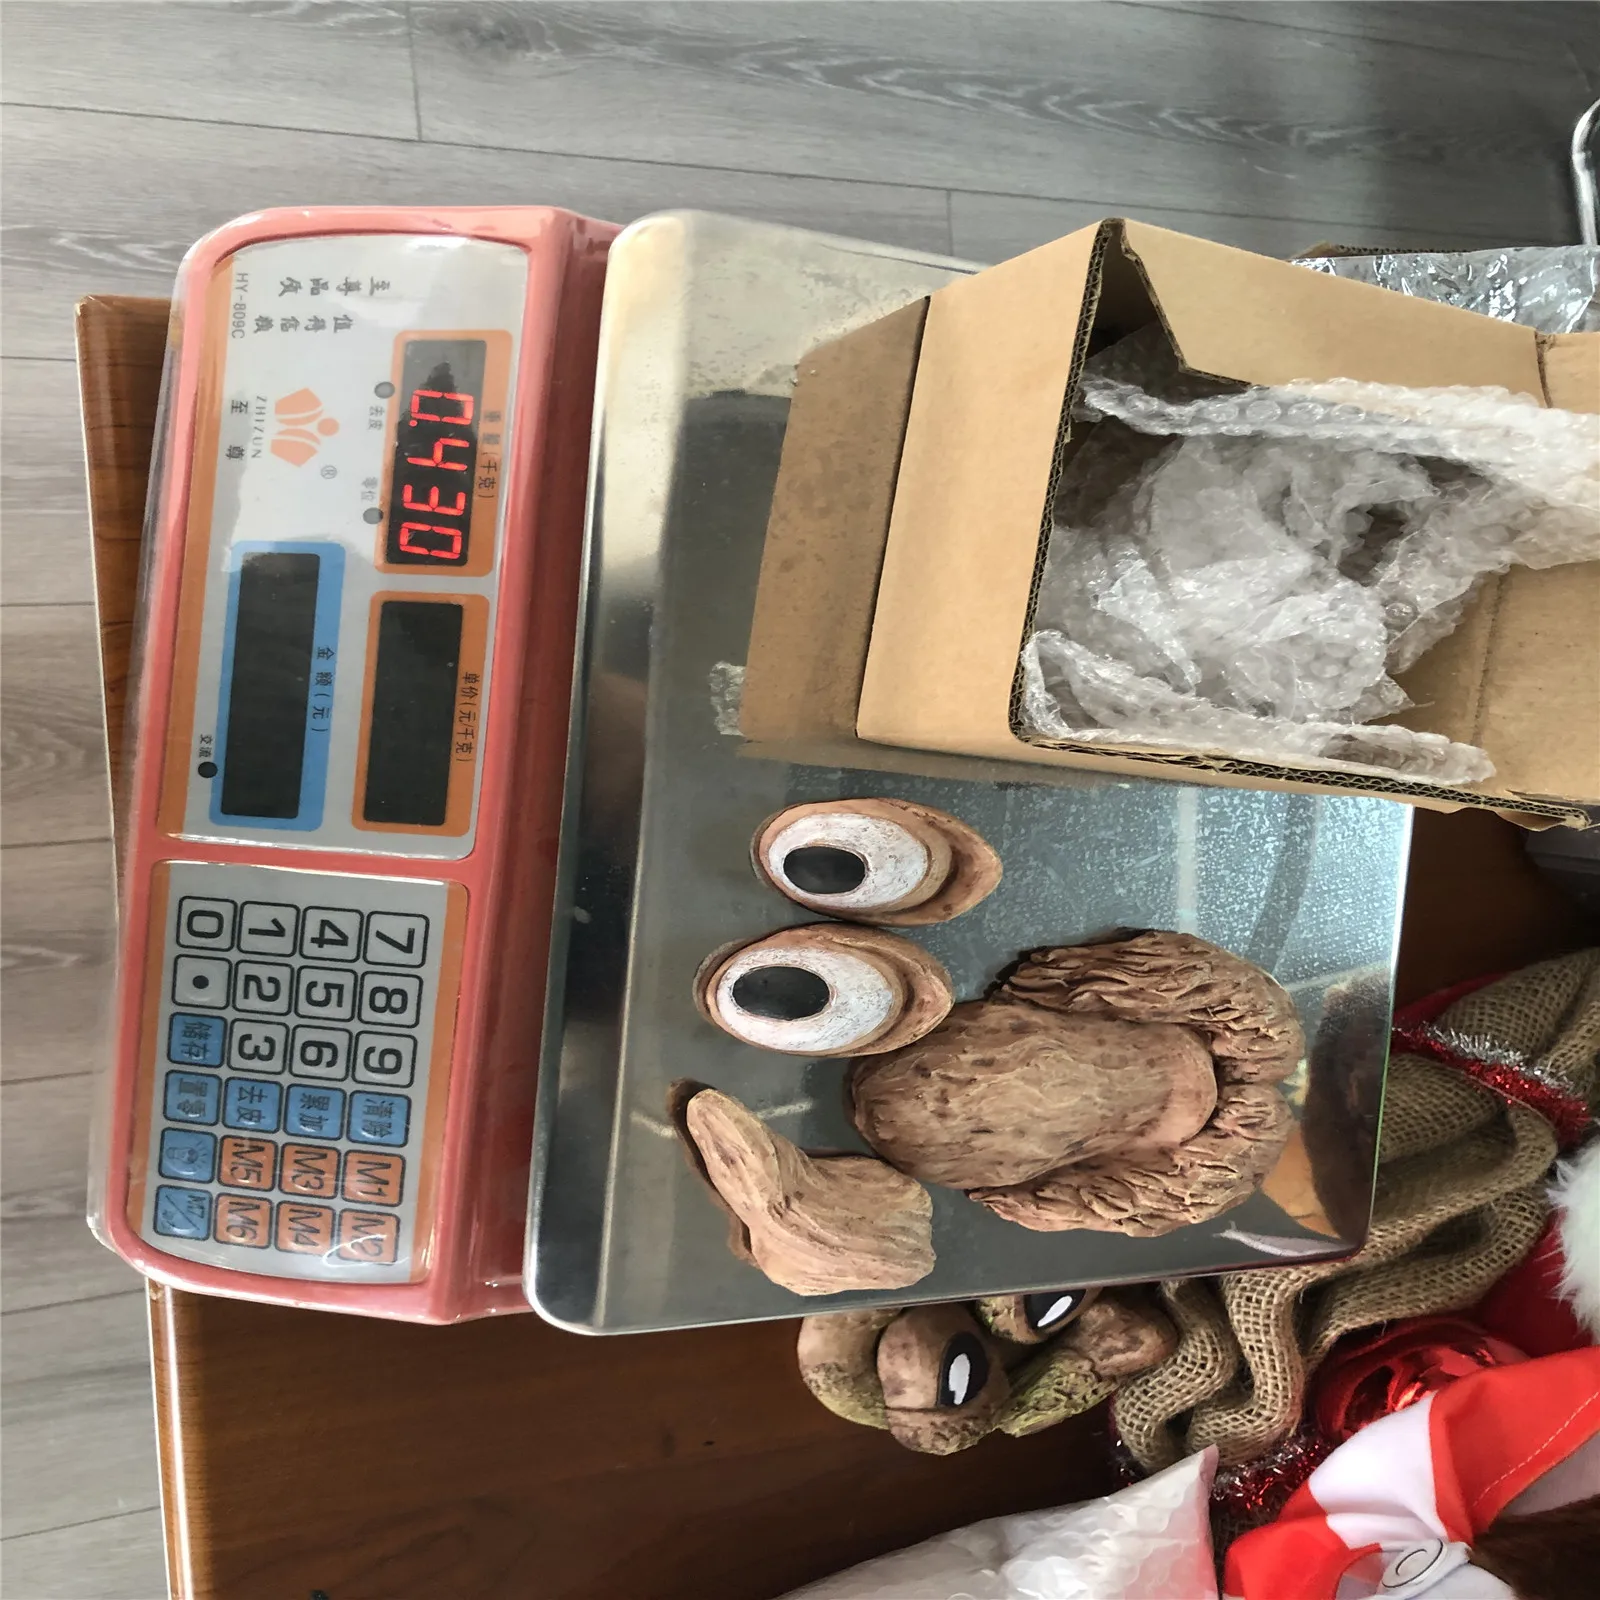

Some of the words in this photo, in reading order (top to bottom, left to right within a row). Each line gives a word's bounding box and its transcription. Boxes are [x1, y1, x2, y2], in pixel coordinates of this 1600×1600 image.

[278, 276, 390, 297] 至尊品质
[231, 272, 249, 339] HY-809C
[253, 314, 353, 334] 值得信赖
[251, 395, 267, 459] ZHIZUN
[366, 405, 385, 431] 去皮
[399, 389, 474, 559] 0.430
[360, 476, 378, 502] 零位
[198, 734, 213, 759] 交流
[186, 910, 224, 938] 0
[248, 917, 286, 937] 1
[310, 919, 349, 948] 4
[375, 927, 415, 954] 7
[243, 974, 281, 1002] 2
[306, 980, 344, 1008] 5
[369, 986, 408, 1015] 8
[181, 1020, 212, 1061] 储存
[238, 1033, 276, 1062] 3
[300, 1039, 338, 1068] 6
[363, 1046, 403, 1075] 9
[177, 1078, 207, 1118] 置零
[236, 1085, 268, 1123] 去皮
[299, 1092, 330, 1132] 累加
[361, 1098, 393, 1139] 清除
[230, 1138, 264, 1184] M5
[291, 1149, 327, 1191] M3
[357, 1160, 392, 1199] M1
[226, 1201, 261, 1241] M6
[288, 1208, 323, 1247] M4
[351, 1216, 385, 1257] M2
